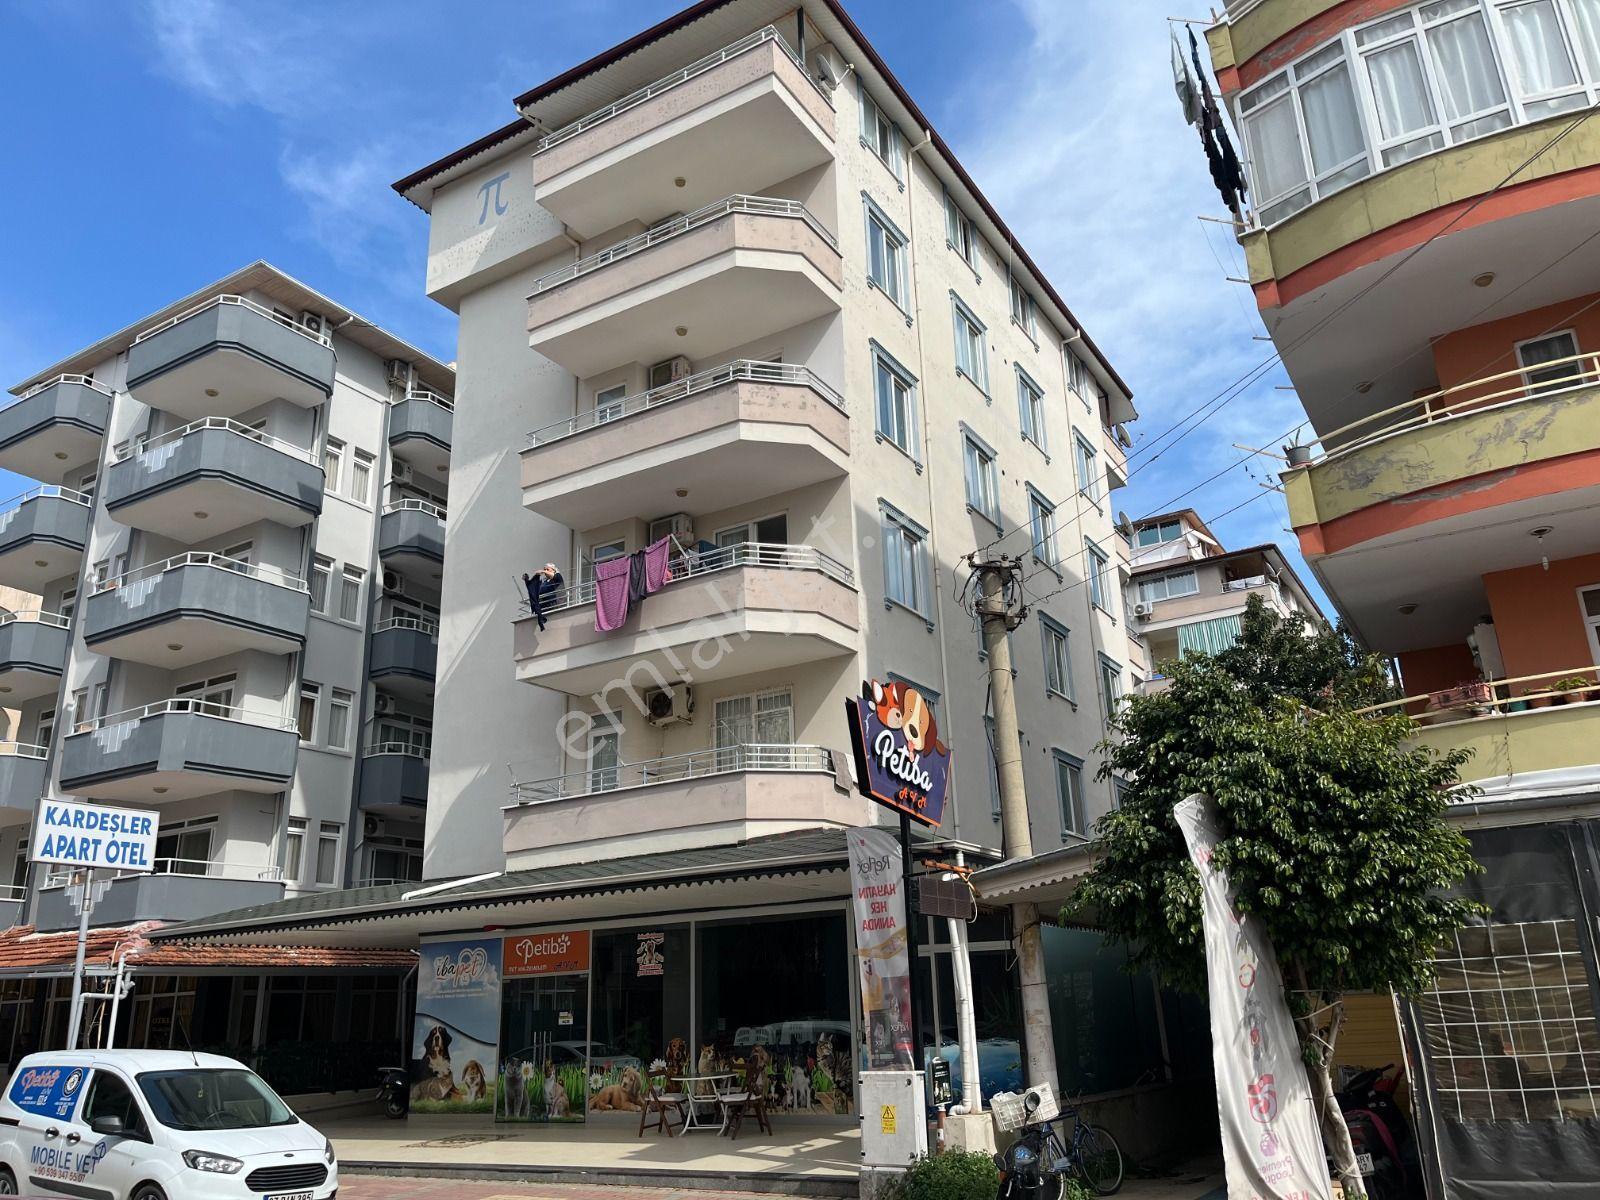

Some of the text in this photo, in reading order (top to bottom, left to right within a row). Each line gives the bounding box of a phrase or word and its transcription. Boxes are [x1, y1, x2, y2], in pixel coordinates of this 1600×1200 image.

[875, 729, 933, 792] Petiba
[44, 806, 152, 839] KARDEŞLER
[40, 834, 148, 864] APART OTEL
[515, 937, 568, 965] Petiba
[31, 1146, 99, 1175] MOBILE VET
